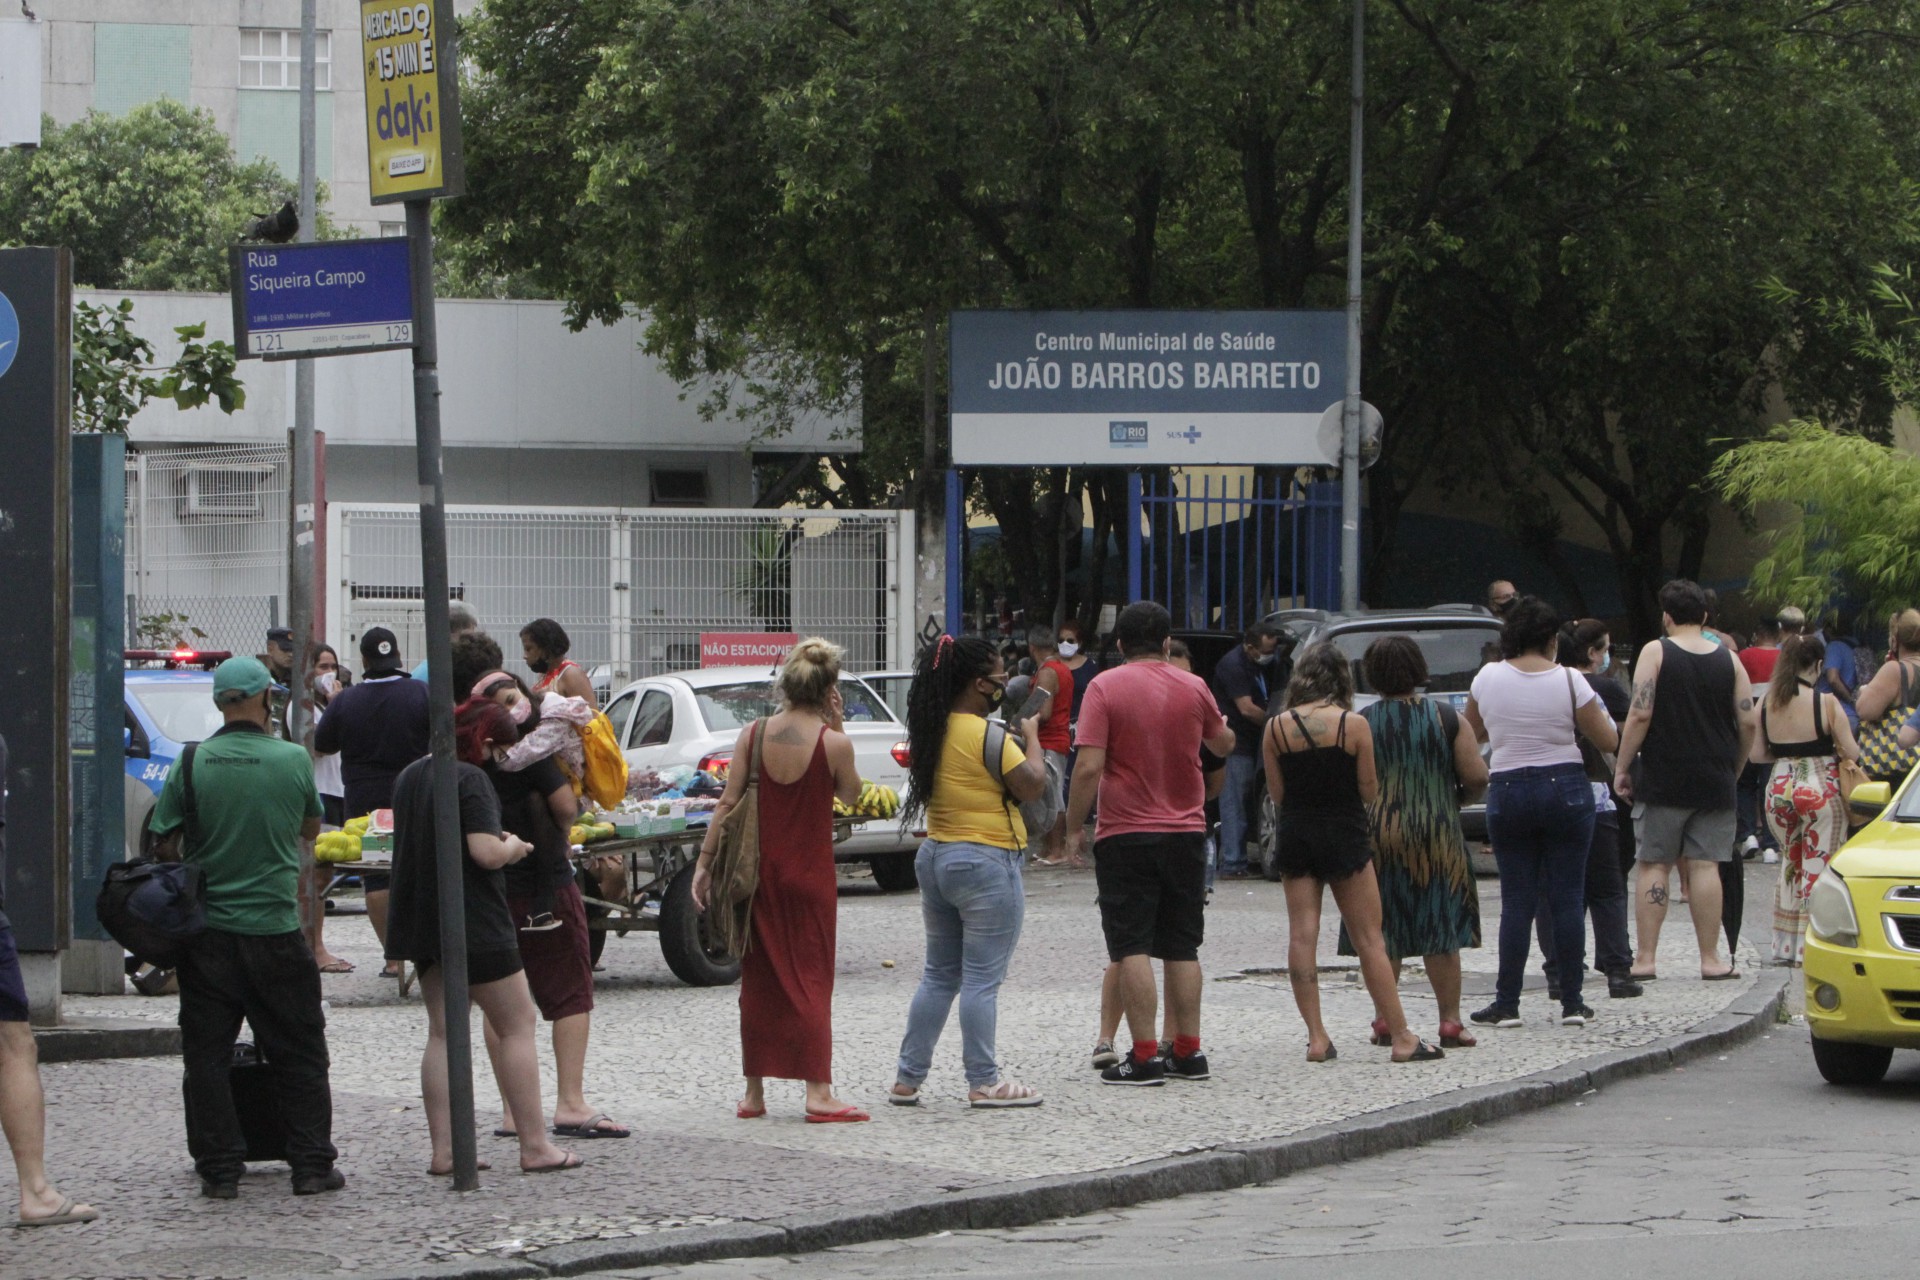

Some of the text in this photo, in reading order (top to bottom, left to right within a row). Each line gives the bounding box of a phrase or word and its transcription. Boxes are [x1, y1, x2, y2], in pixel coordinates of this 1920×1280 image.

[364, 3, 431, 40] MERCADO
[375, 46, 394, 81] 15
[394, 42, 419, 78] MIN
[376, 84, 433, 146] daki
[248, 252, 277, 268] Rua
[249, 270, 366, 294] Siqueira Campo
[255, 333, 284, 352] 121
[385, 325, 409, 342] 129
[1035, 331, 1276, 355] Centro Municipal de Saúde
[988, 357, 1321, 390] JOÃO BARROS BARRETO
[1128, 427, 1146, 437] RIO
[703, 642, 793, 656] NÃO ESTACIONE
